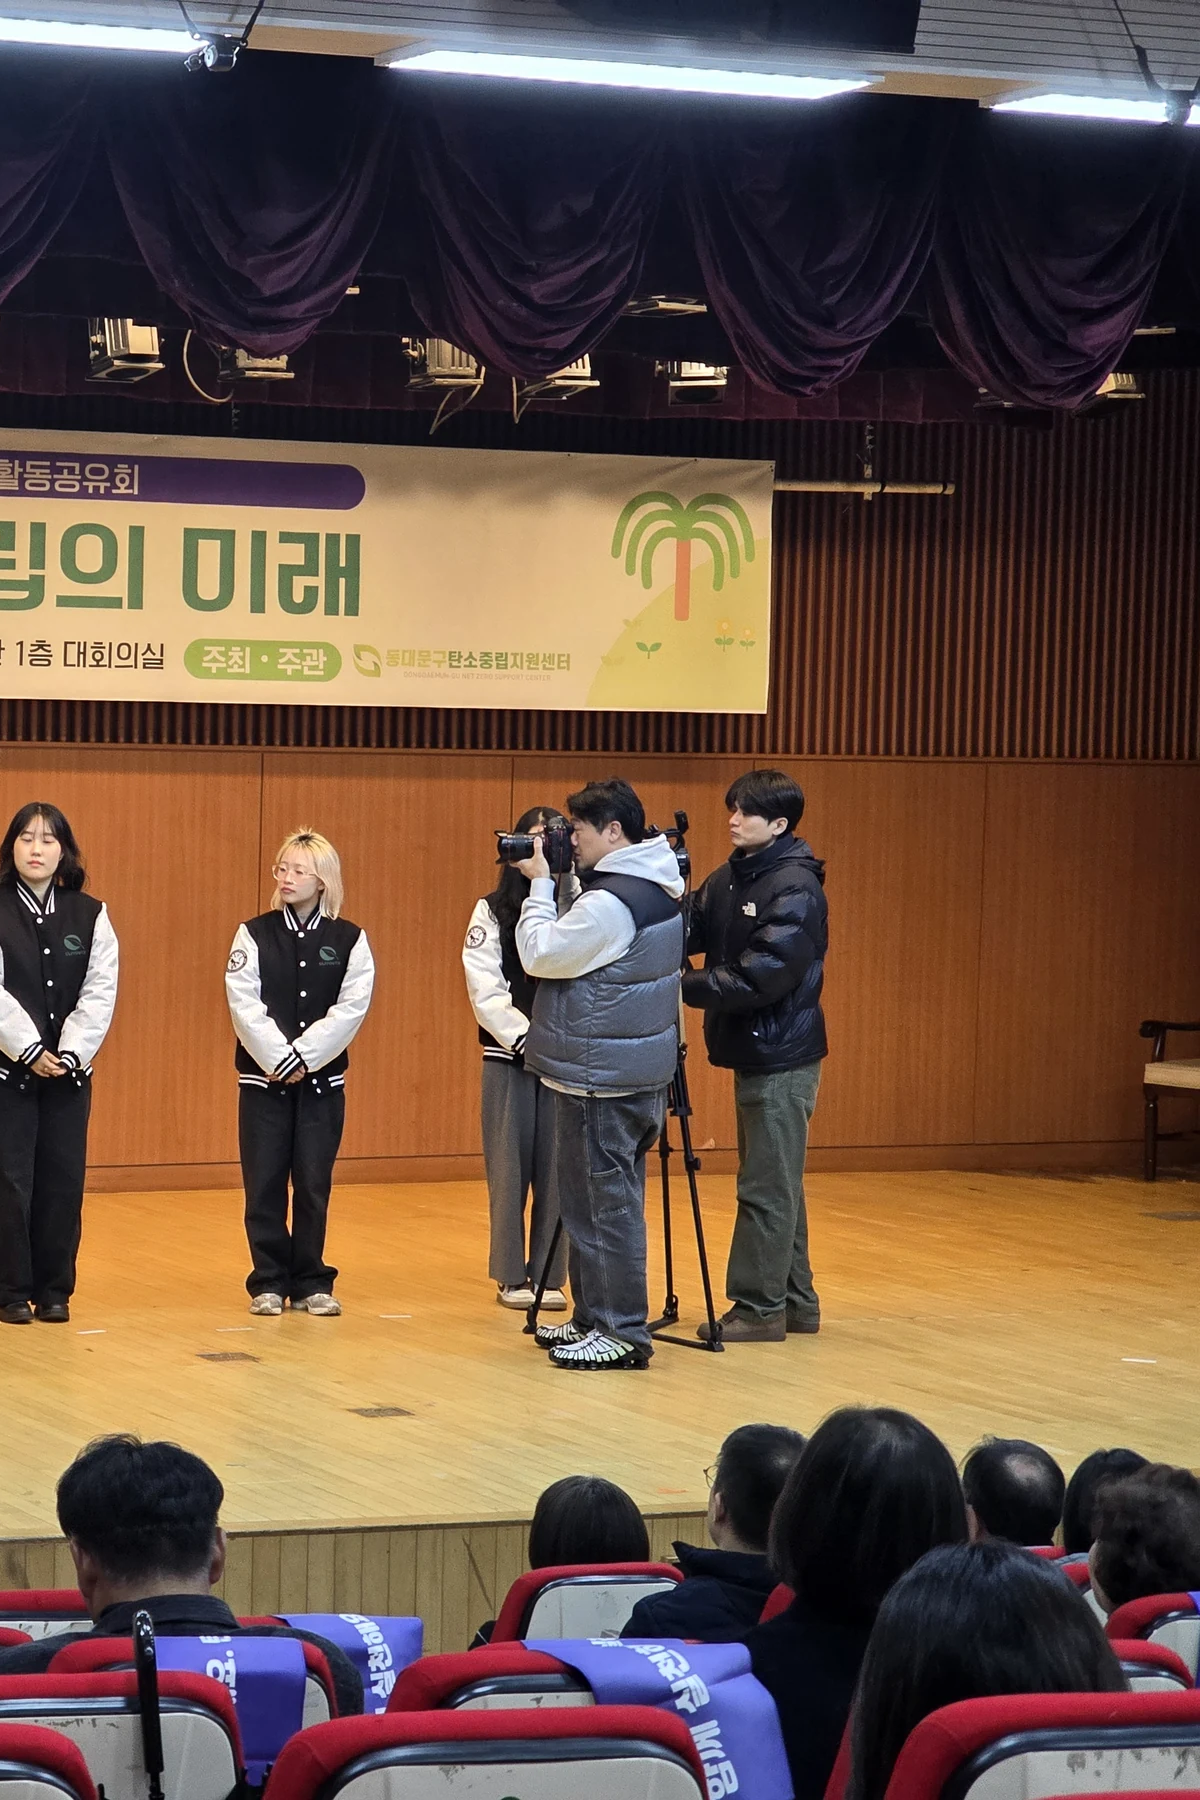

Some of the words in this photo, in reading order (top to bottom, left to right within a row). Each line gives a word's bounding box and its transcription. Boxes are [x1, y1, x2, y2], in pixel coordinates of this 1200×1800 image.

[181, 527, 361, 617] 미래
[14, 639, 54, 669] 1층
[63, 639, 165, 670] 대회의실
[202, 644, 251, 675] 주최
[277, 648, 327, 677] 주관
[386, 649, 571, 671] 동대문구탄소중립지원센터
